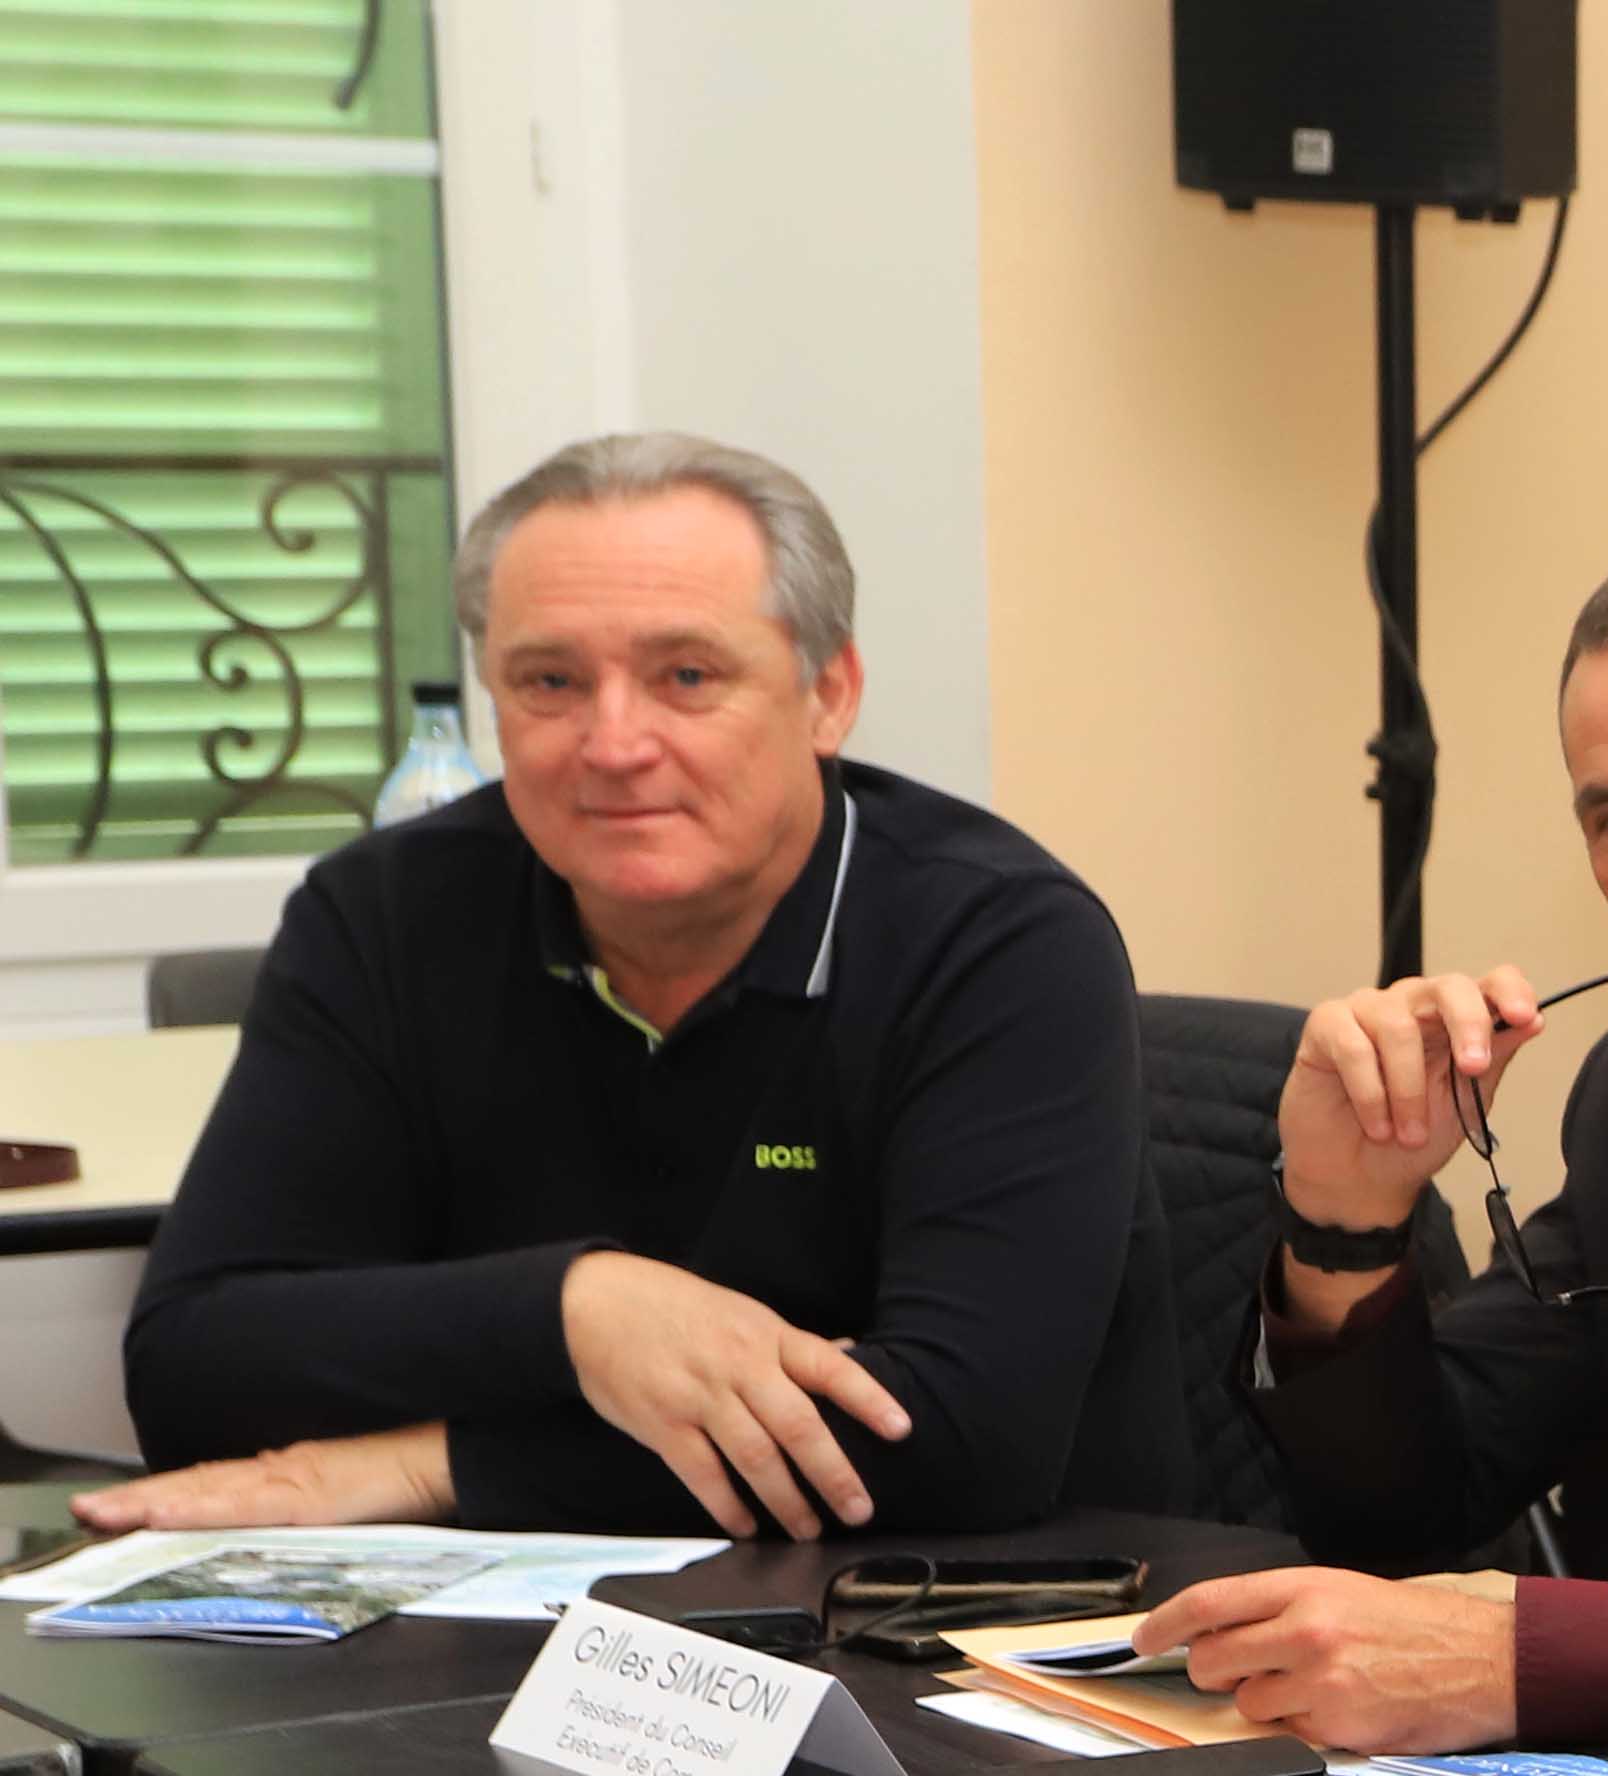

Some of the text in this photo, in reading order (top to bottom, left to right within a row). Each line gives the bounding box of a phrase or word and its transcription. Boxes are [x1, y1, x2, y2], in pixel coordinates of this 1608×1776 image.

[754, 1142, 817, 1171] BOSS
[573, 1625, 791, 1723] Gilles SIMEONI
[643, 1714, 670, 1743] du
[669, 1722, 737, 1763] Conseil
[624, 1748, 651, 1776] de
